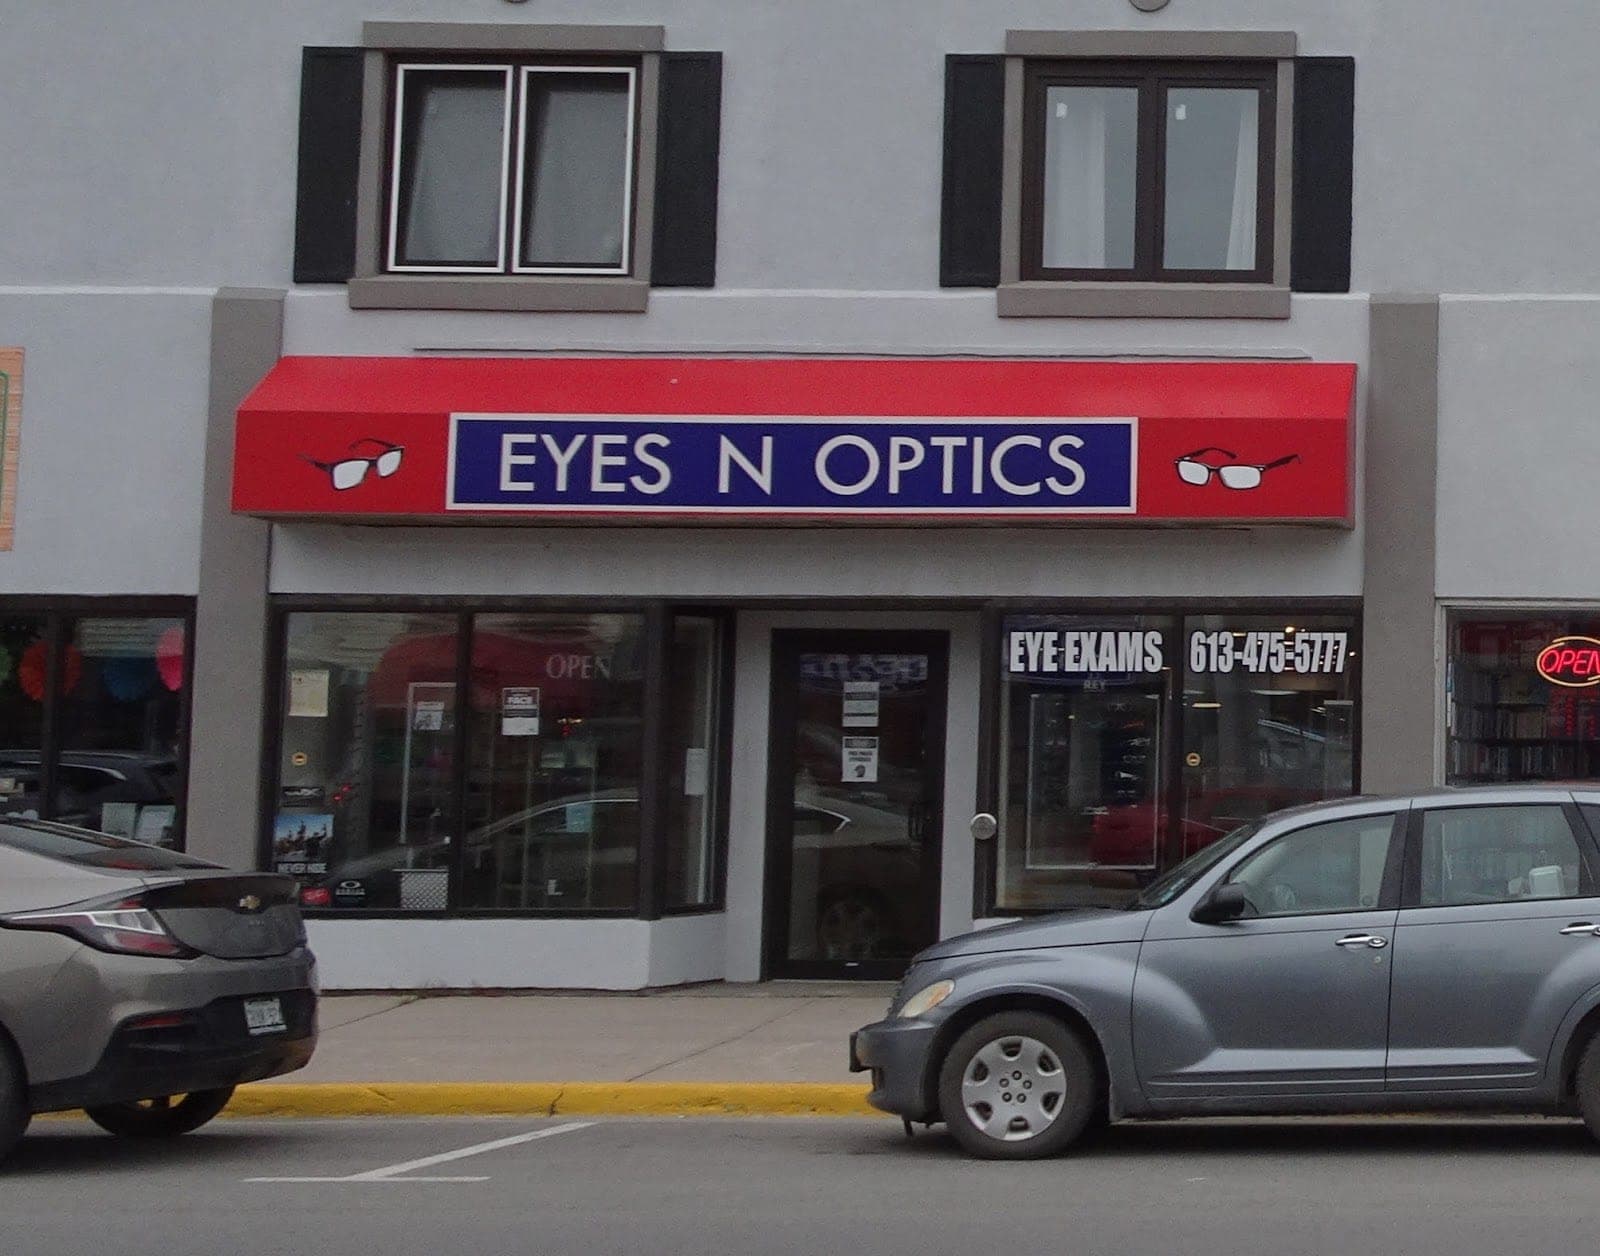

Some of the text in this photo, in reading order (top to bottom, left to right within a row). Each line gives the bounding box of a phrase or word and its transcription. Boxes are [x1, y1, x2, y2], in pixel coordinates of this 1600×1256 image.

[500, 433, 1086, 496] EYES N OPTICS
[545, 653, 613, 680] OPEN
[1009, 630, 1164, 674] EYE EXAMS
[1189, 631, 1348, 674] 613-475-5777
[1540, 649, 1600, 675] OPEN
